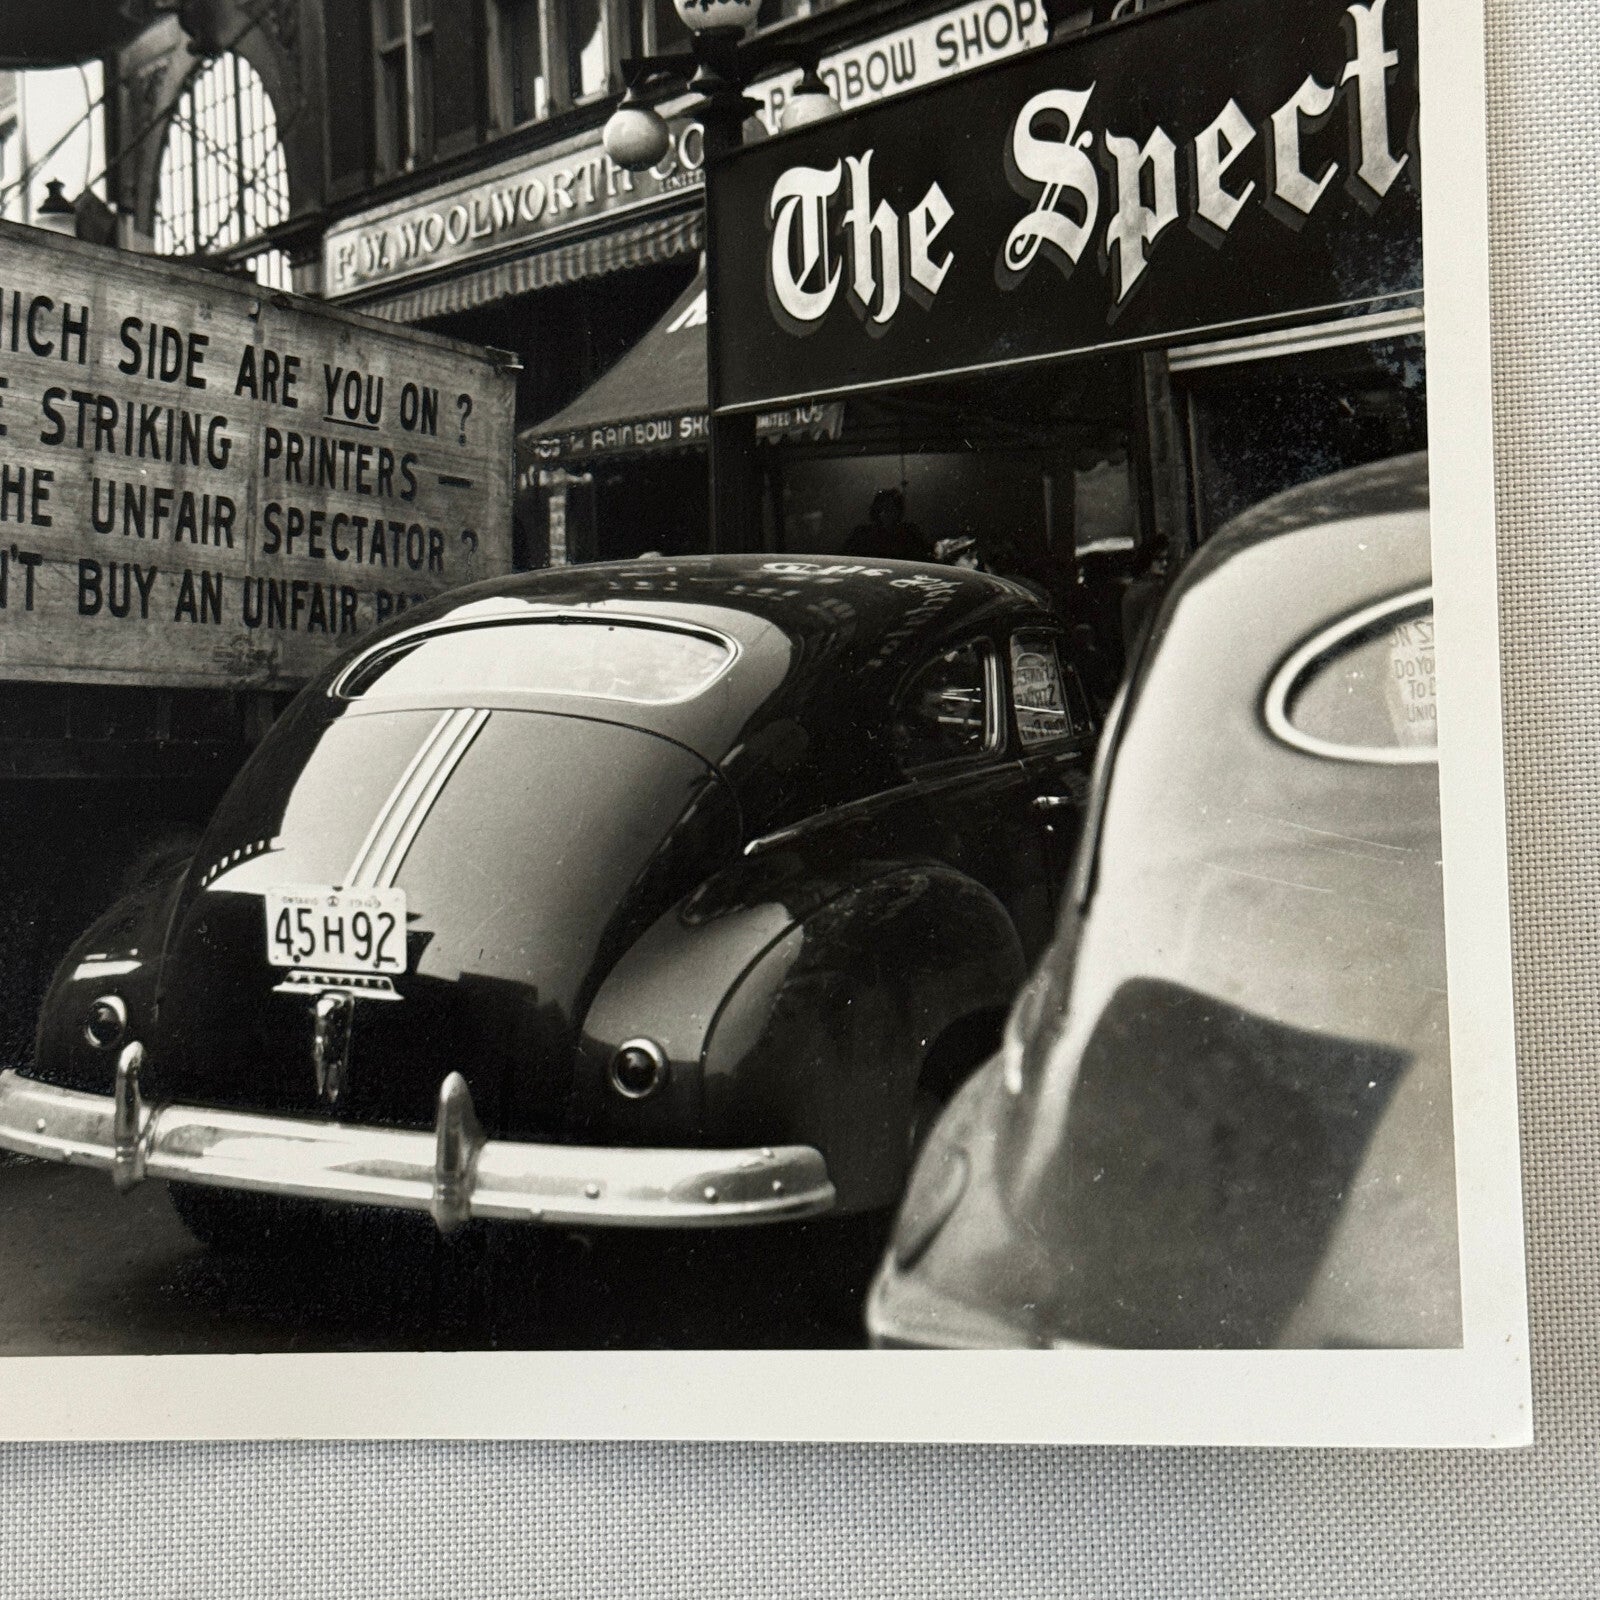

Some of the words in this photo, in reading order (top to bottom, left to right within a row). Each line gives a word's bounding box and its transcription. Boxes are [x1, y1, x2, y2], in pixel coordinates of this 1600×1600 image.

[396, 148, 635, 260] WOOLWORTH
[770, 148, 955, 325] The
[0, 286, 89, 365] ICH
[118, 315, 210, 390] SIDE
[234, 343, 301, 408] ARE
[322, 363, 384, 426] YOU
[401, 383, 438, 437] ON
[457, 393, 473, 447] ?
[40, 386, 232, 470] STRIKING
[263, 426, 419, 501] PRINTERS
[91, 476, 237, 549] UNFAIR
[262, 502, 445, 574] SPECTATOR
[0, 543, 43, 611] 'T
[78, 558, 156, 619] BUY
[174, 568, 223, 625] AN
[242, 575, 358, 634] UNFAIR
[1407, 679, 1426, 699] TO
[275, 906, 397, 962] 45H92
